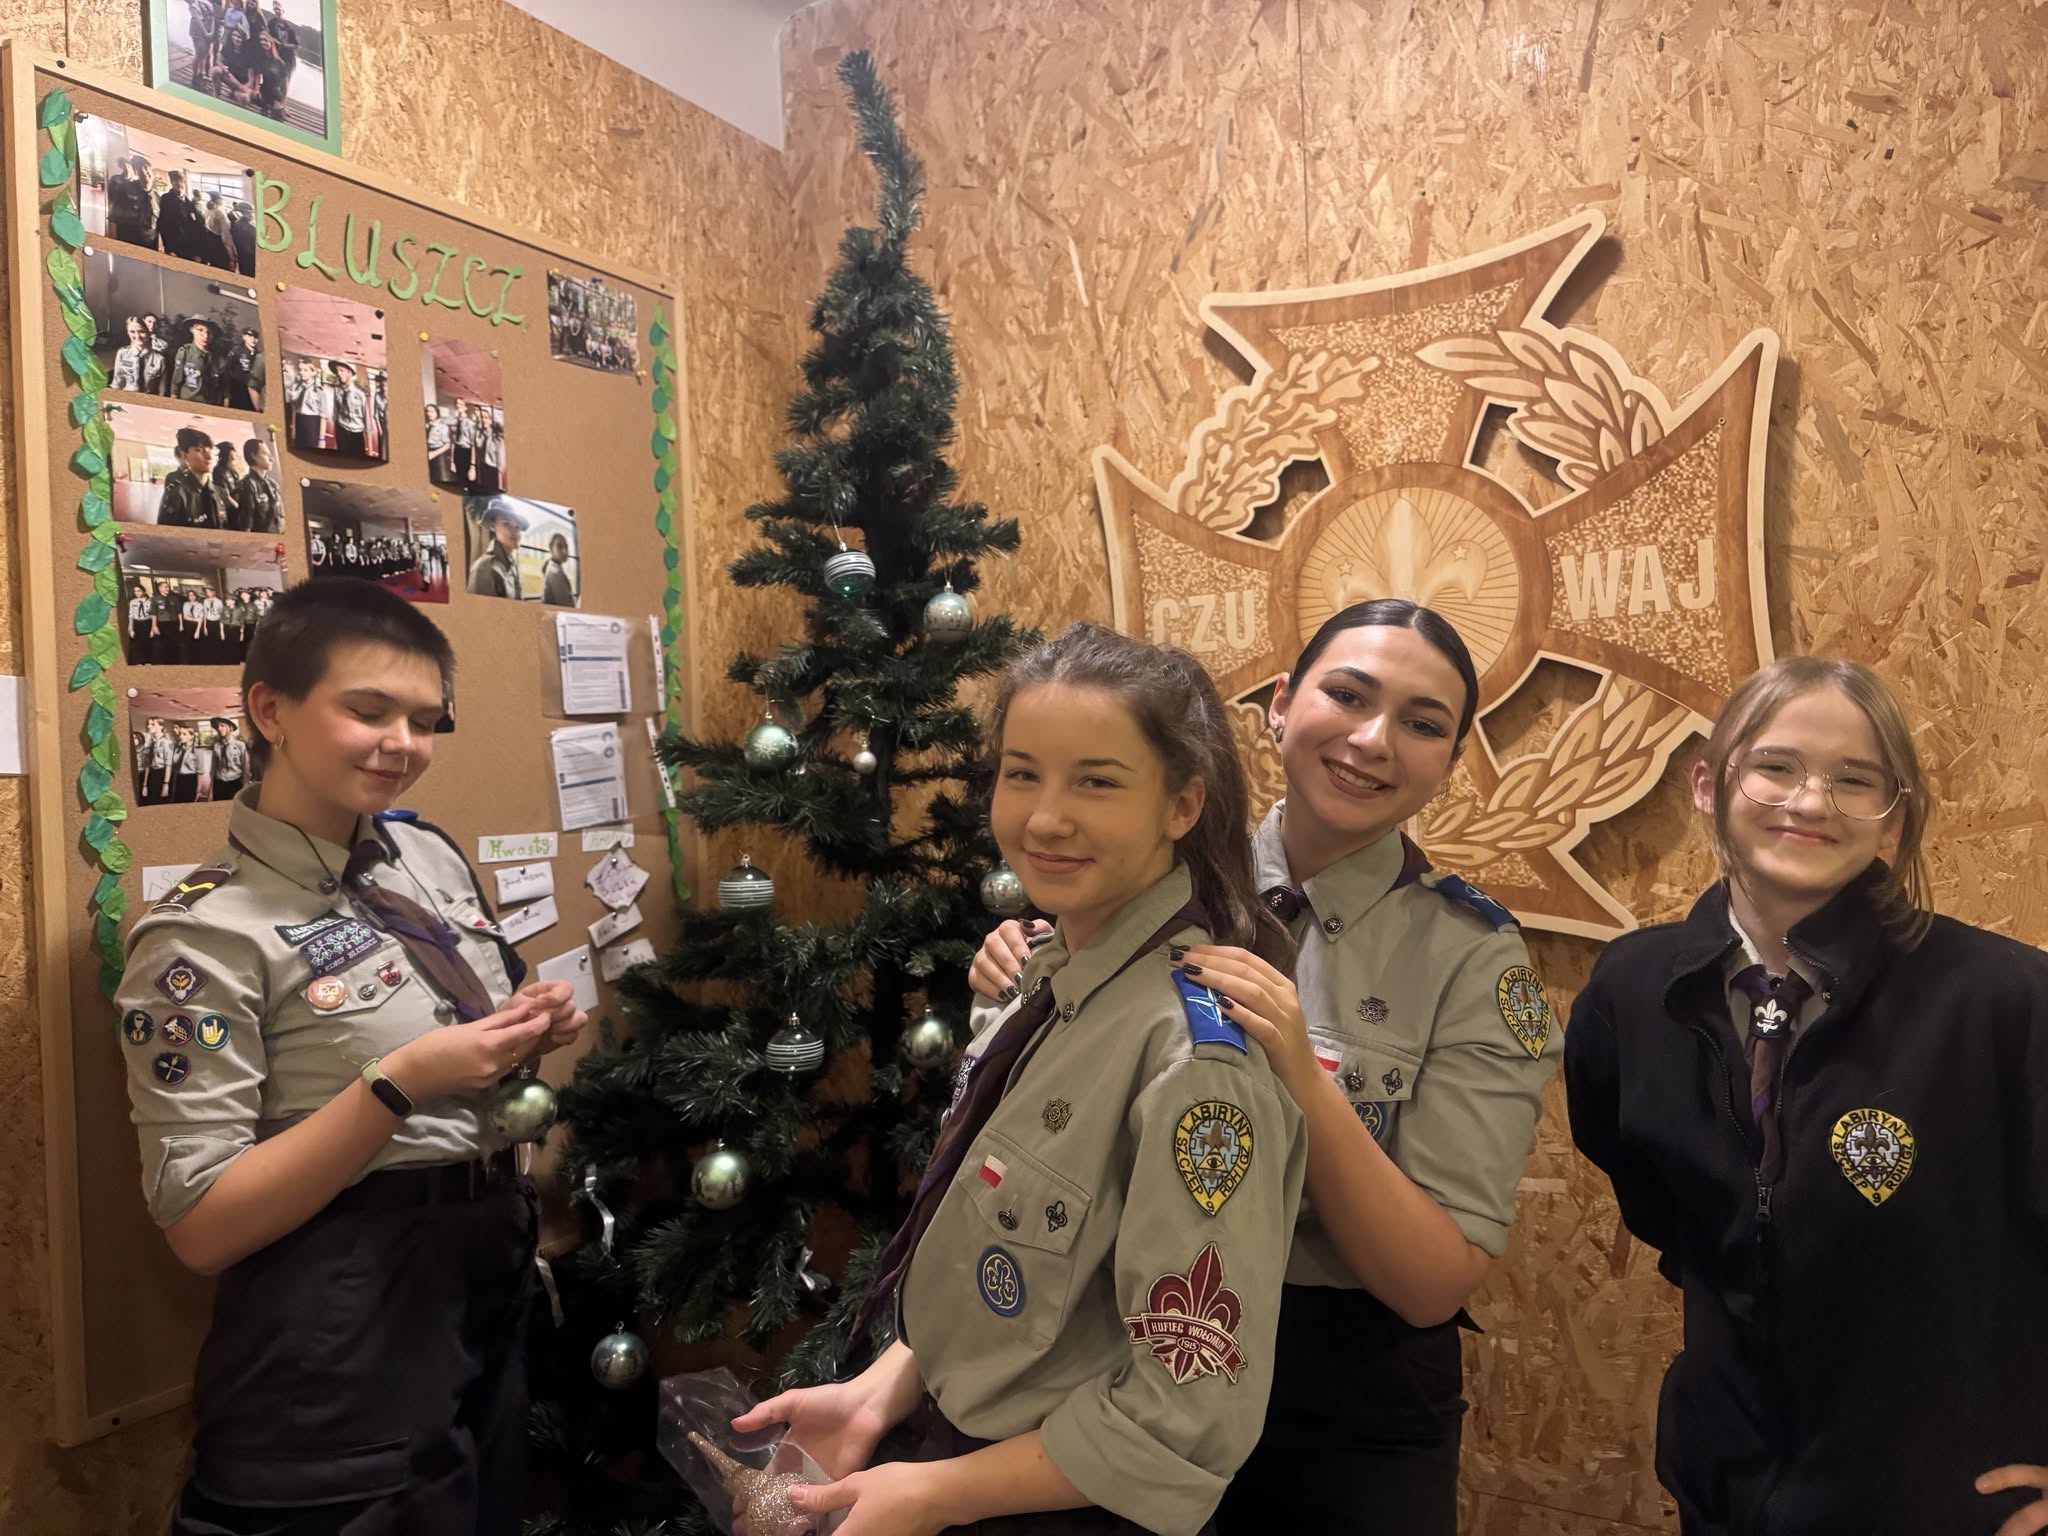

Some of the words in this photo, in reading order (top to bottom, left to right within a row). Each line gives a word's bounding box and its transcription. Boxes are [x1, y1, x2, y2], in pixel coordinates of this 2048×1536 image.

[255, 171, 527, 327] BLUSZCZ
[1560, 538, 1716, 622] WAJ
[1152, 589, 1255, 652] CZU
[1499, 969, 1544, 994] LABIRYNT
[1500, 998, 1529, 1042] SZCZEP
[1179, 1104, 1252, 1138] LABIRYNT
[1833, 1110, 1912, 1140] LABIRYNT
[1176, 1137, 1204, 1195] SZCZEP
[1833, 1142, 1868, 1189] SZCZEP
[1206, 1201, 1215, 1212] 9
[1872, 1192, 1881, 1203] 9
[1151, 1321, 1184, 1334] HUFIEC
[1188, 1324, 1227, 1353] WOŁOMIN
